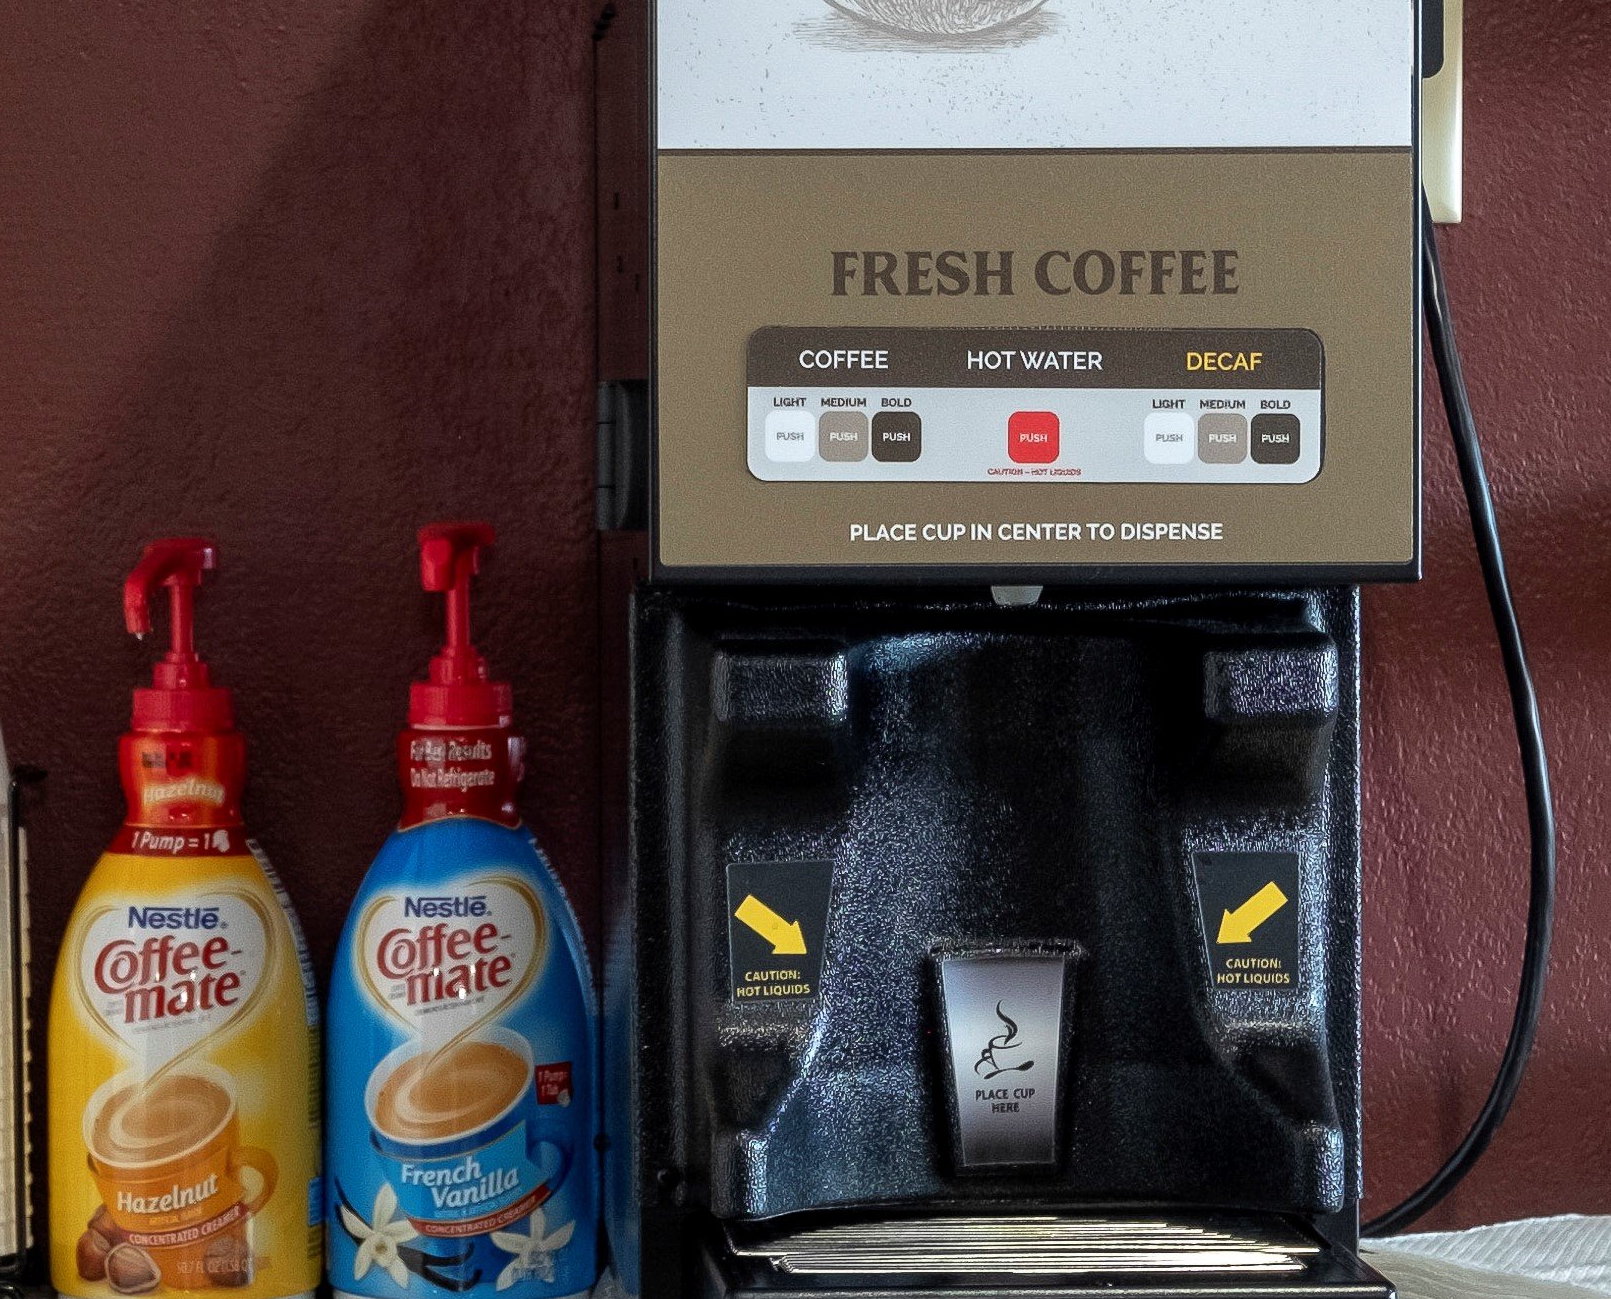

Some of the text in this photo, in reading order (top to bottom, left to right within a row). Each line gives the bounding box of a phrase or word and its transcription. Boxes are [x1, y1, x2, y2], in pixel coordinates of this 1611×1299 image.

[830, 249, 1240, 298] FRESH COFFEE
[798, 349, 889, 370] COFFEE
[966, 349, 1104, 371] HOT WATER
[1185, 351, 1263, 372] DECAF
[773, 397, 807, 408] LIGHT
[820, 397, 867, 408] MEDIUM
[880, 397, 913, 408] BOLD
[1151, 398, 1186, 410] LIGHT
[1199, 398, 1246, 410] MEDIUM
[1260, 399, 1291, 410] BOLD
[776, 431, 805, 441] PUSH
[829, 431, 858, 442] PUSH
[882, 431, 911, 442] PUSH
[1019, 432, 1048, 443] PUSH
[1155, 433, 1184, 443] PUSH
[1208, 433, 1237, 443] PUSH
[1261, 433, 1290, 444] PUSH
[849, 522, 1224, 542] PLACE CUP IN CENTER TO DISPENSE
[139, 831, 185, 854] Pump
[406, 955, 512, 1006] mate
[744, 969, 801, 981] CAUTION:
[1217, 973, 1291, 984] HOT LIQUIDS
[736, 984, 811, 997] HOT LIQUIDS
[124, 971, 241, 1024] mate
[975, 1087, 1036, 1101] PLACE CUP
[991, 1101, 1021, 1114] HERE
[401, 1156, 482, 1187] French
[116, 1173, 218, 1214] Hazelnut
[430, 1167, 520, 1208] Vanilla
